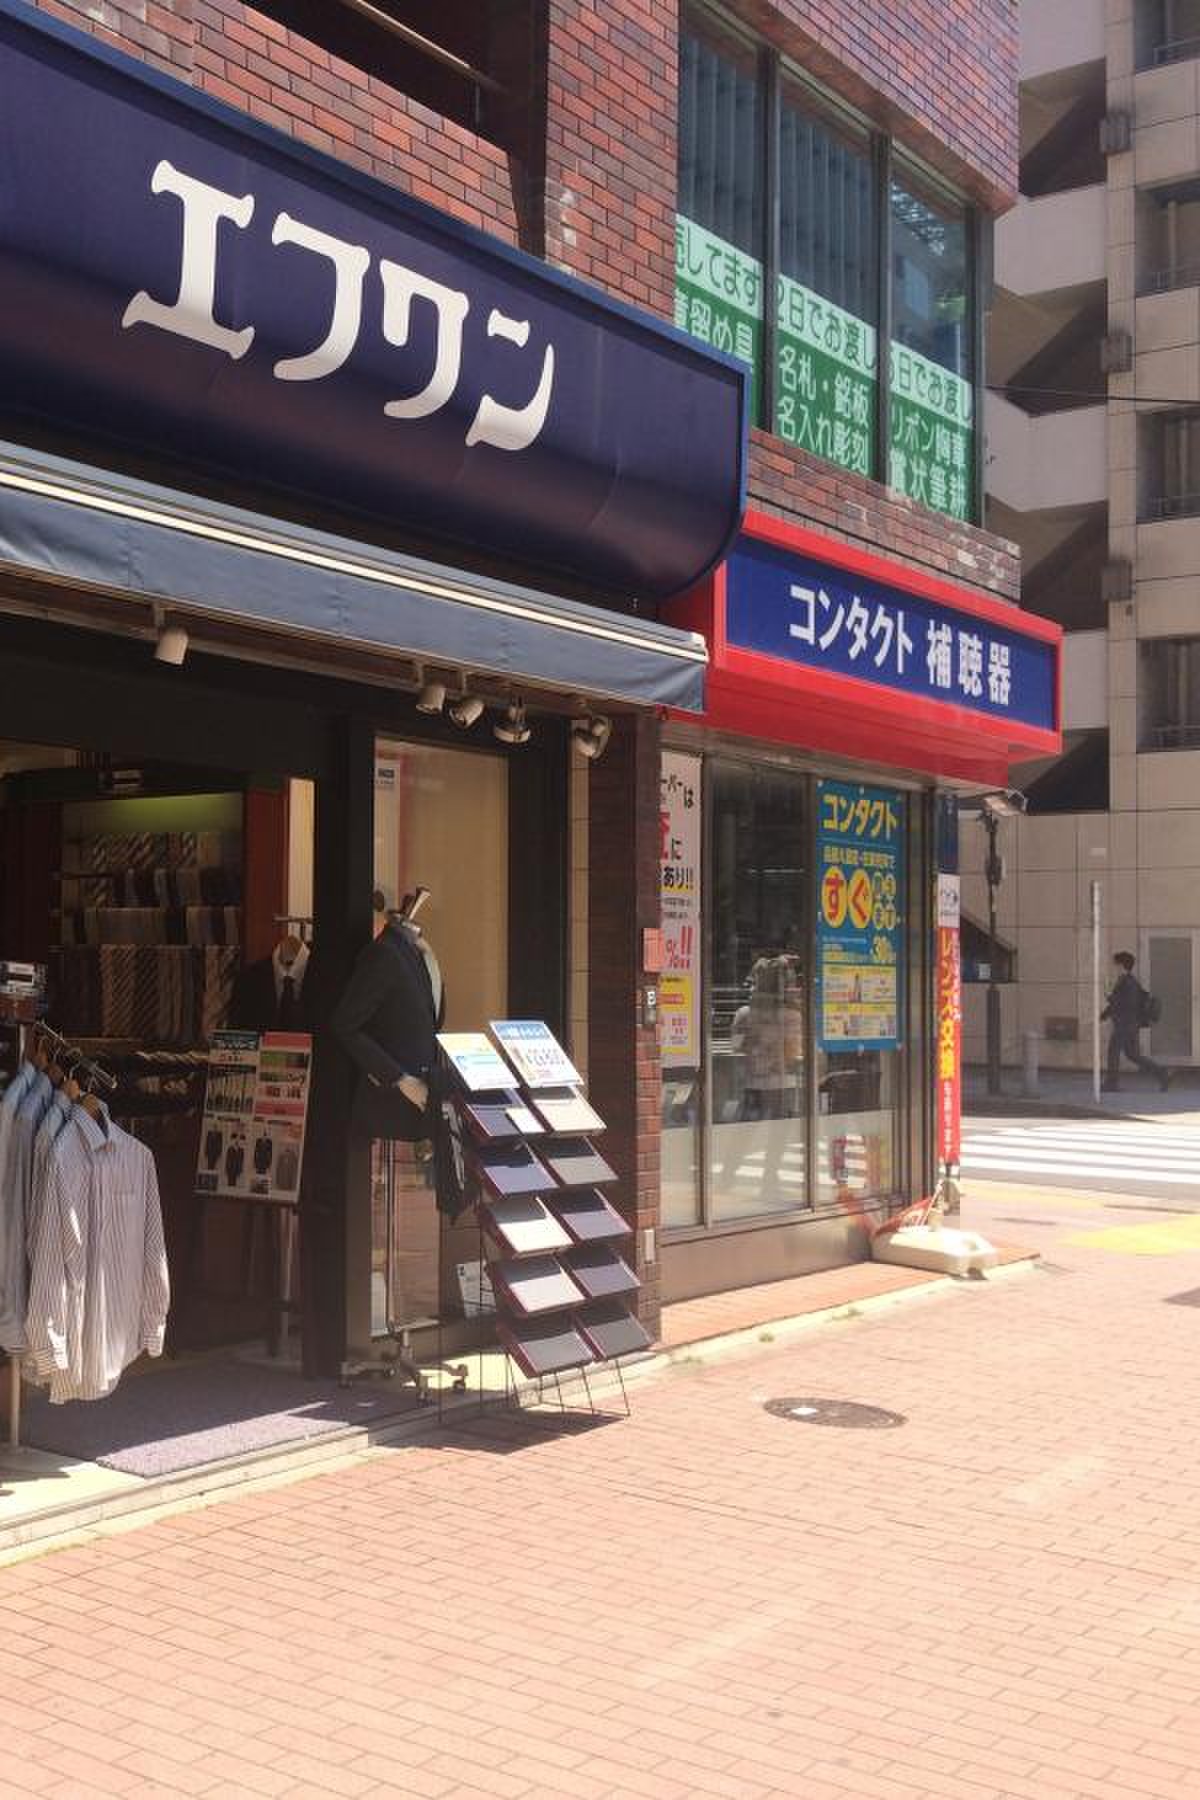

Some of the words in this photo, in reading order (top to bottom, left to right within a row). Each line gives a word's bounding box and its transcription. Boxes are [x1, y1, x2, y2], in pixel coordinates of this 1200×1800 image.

[122, 160, 554, 450] エフワン
[778, 345, 869, 429] 名札・銘板
[777, 396, 869, 477] 名入れ彫刻
[789, 582, 913, 675] コンタクト
[926, 619, 1012, 706] 補聴器
[822, 794, 898, 841] コンタクト
